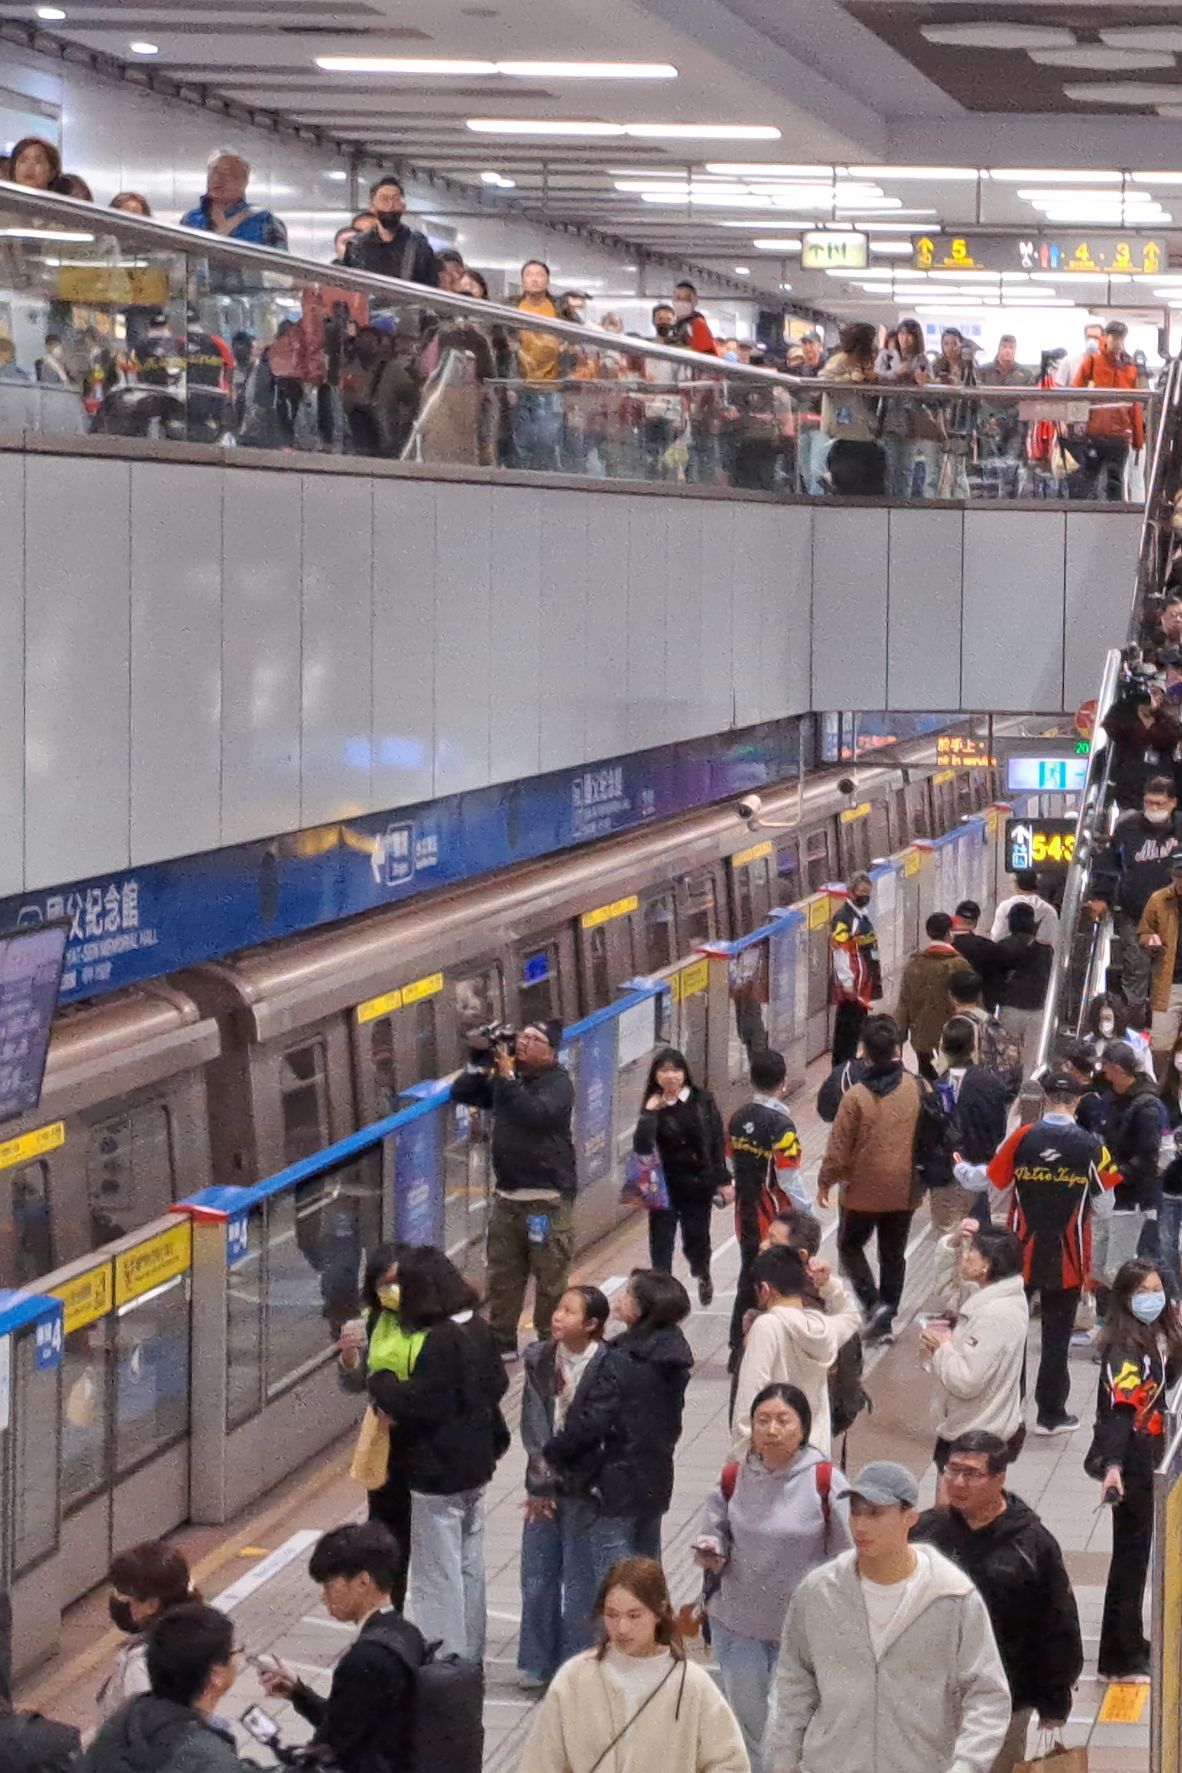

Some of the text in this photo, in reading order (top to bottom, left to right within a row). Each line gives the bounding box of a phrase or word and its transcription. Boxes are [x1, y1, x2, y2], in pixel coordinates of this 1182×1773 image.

[952, 239, 967, 258] 5
[1075, 242, 1130, 261] 4 3
